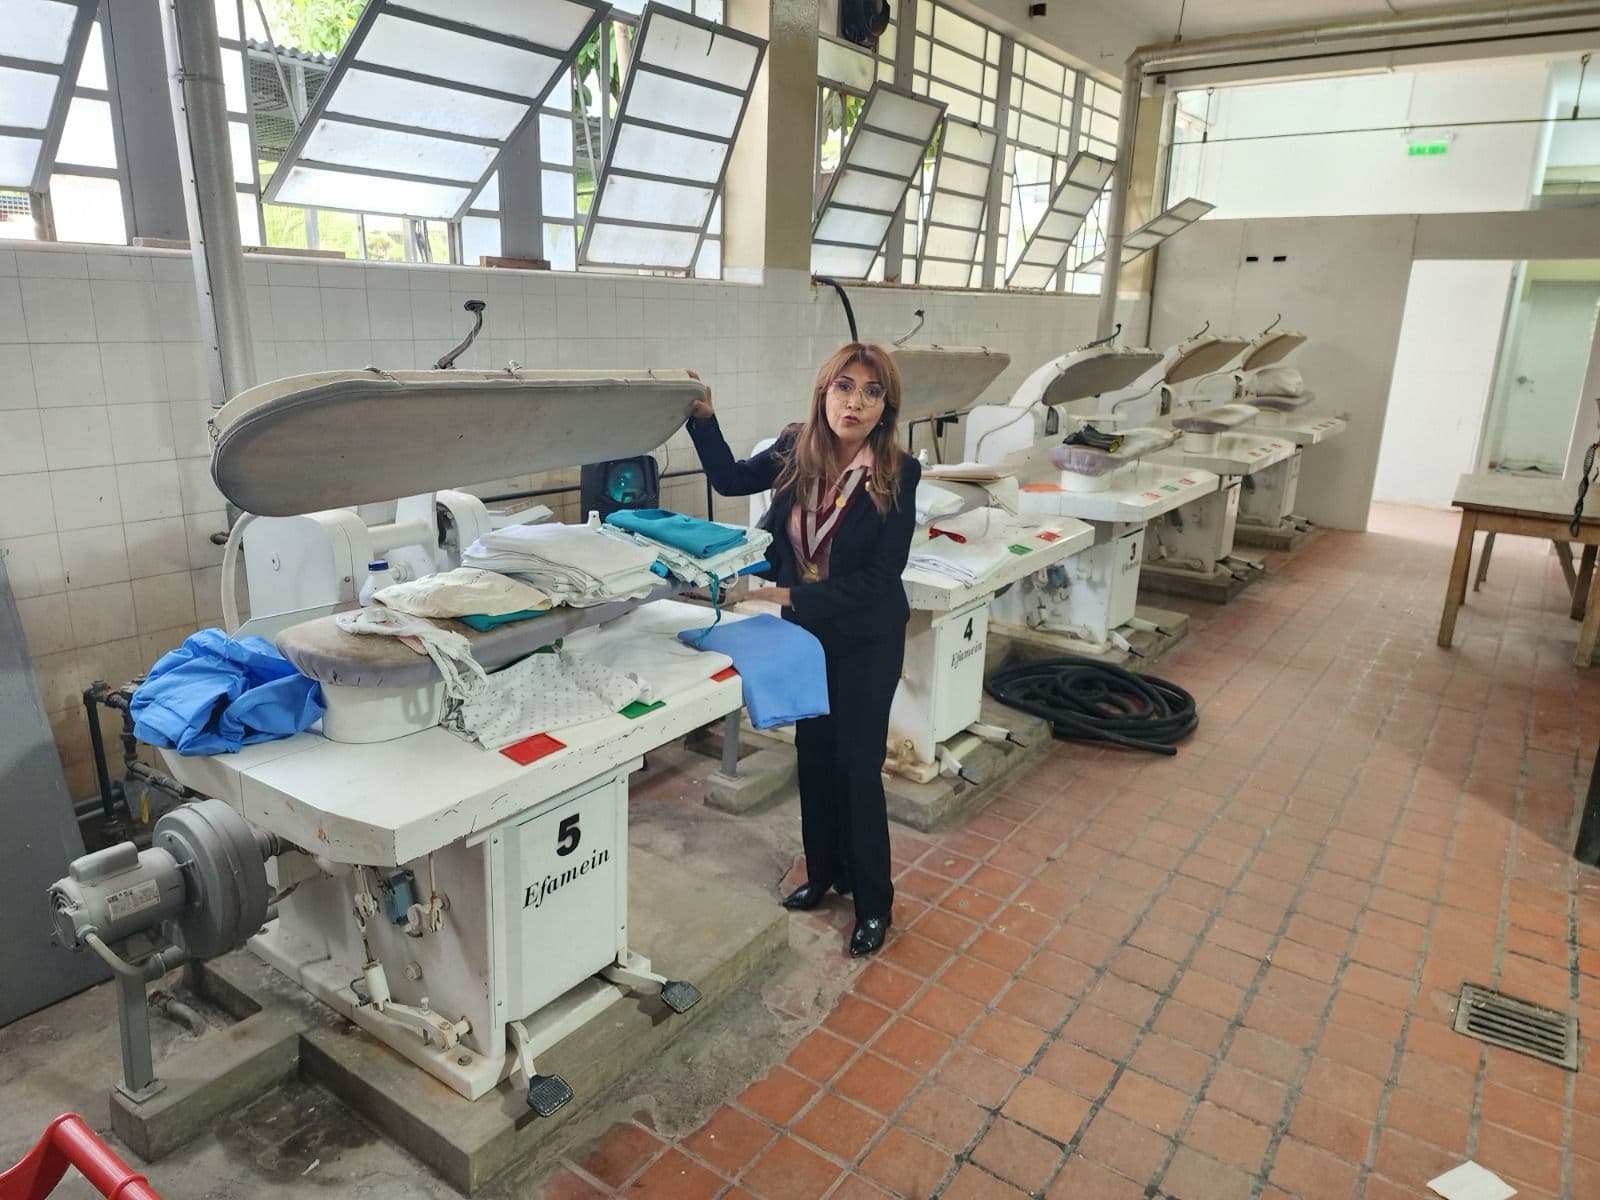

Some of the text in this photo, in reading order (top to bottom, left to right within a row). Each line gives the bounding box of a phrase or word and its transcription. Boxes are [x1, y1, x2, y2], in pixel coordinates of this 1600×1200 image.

[963, 617, 974, 641] 4
[556, 812, 582, 857] 5
[522, 848, 610, 910] Efamein
